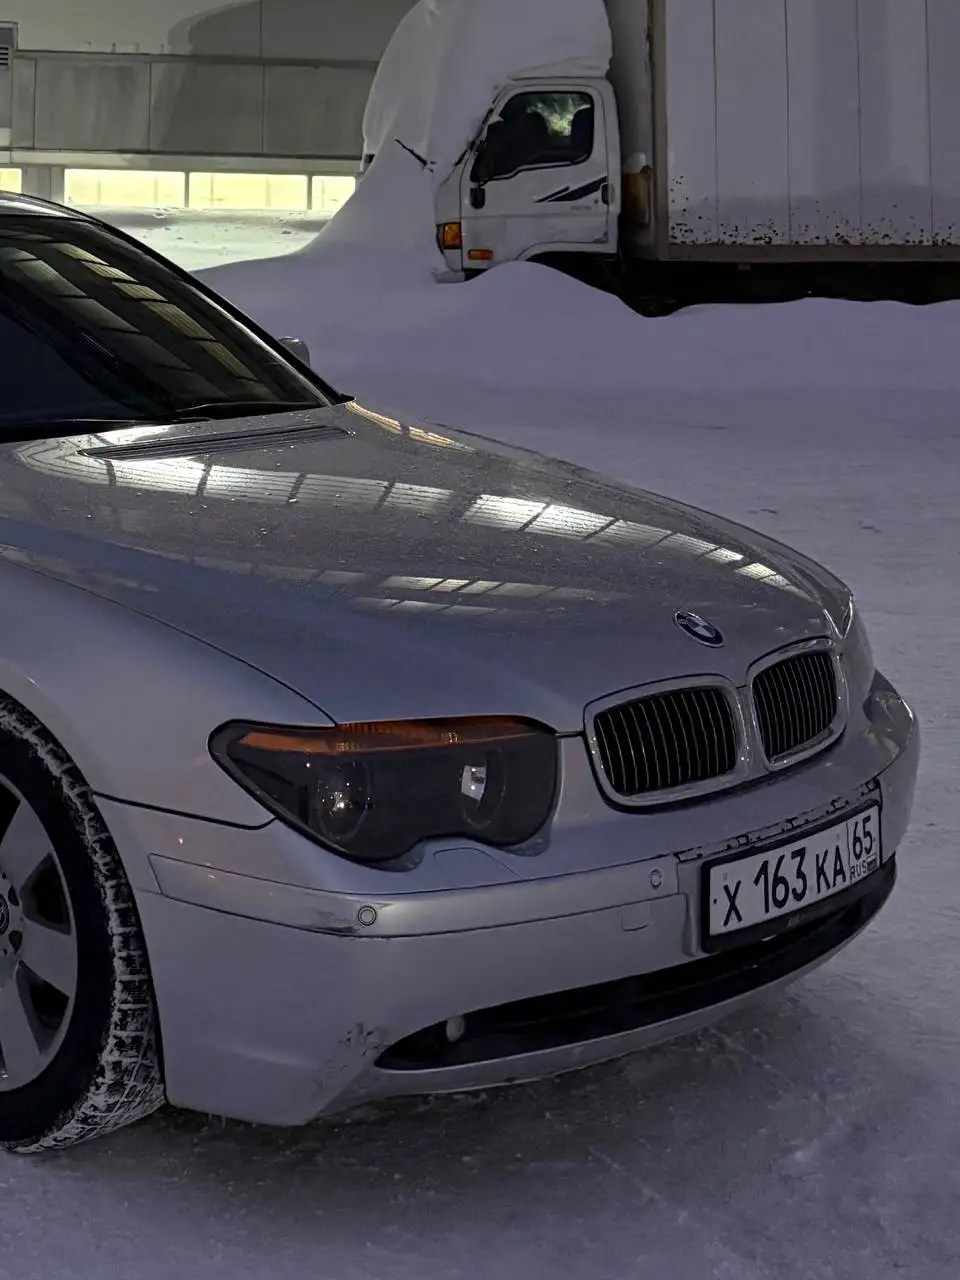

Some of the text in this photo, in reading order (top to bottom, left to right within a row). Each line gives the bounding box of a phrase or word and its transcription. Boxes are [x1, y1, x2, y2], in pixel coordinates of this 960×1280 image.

[753, 847, 807, 913] 163
[852, 816, 873, 860] 65
[850, 861, 867, 880] RUS
